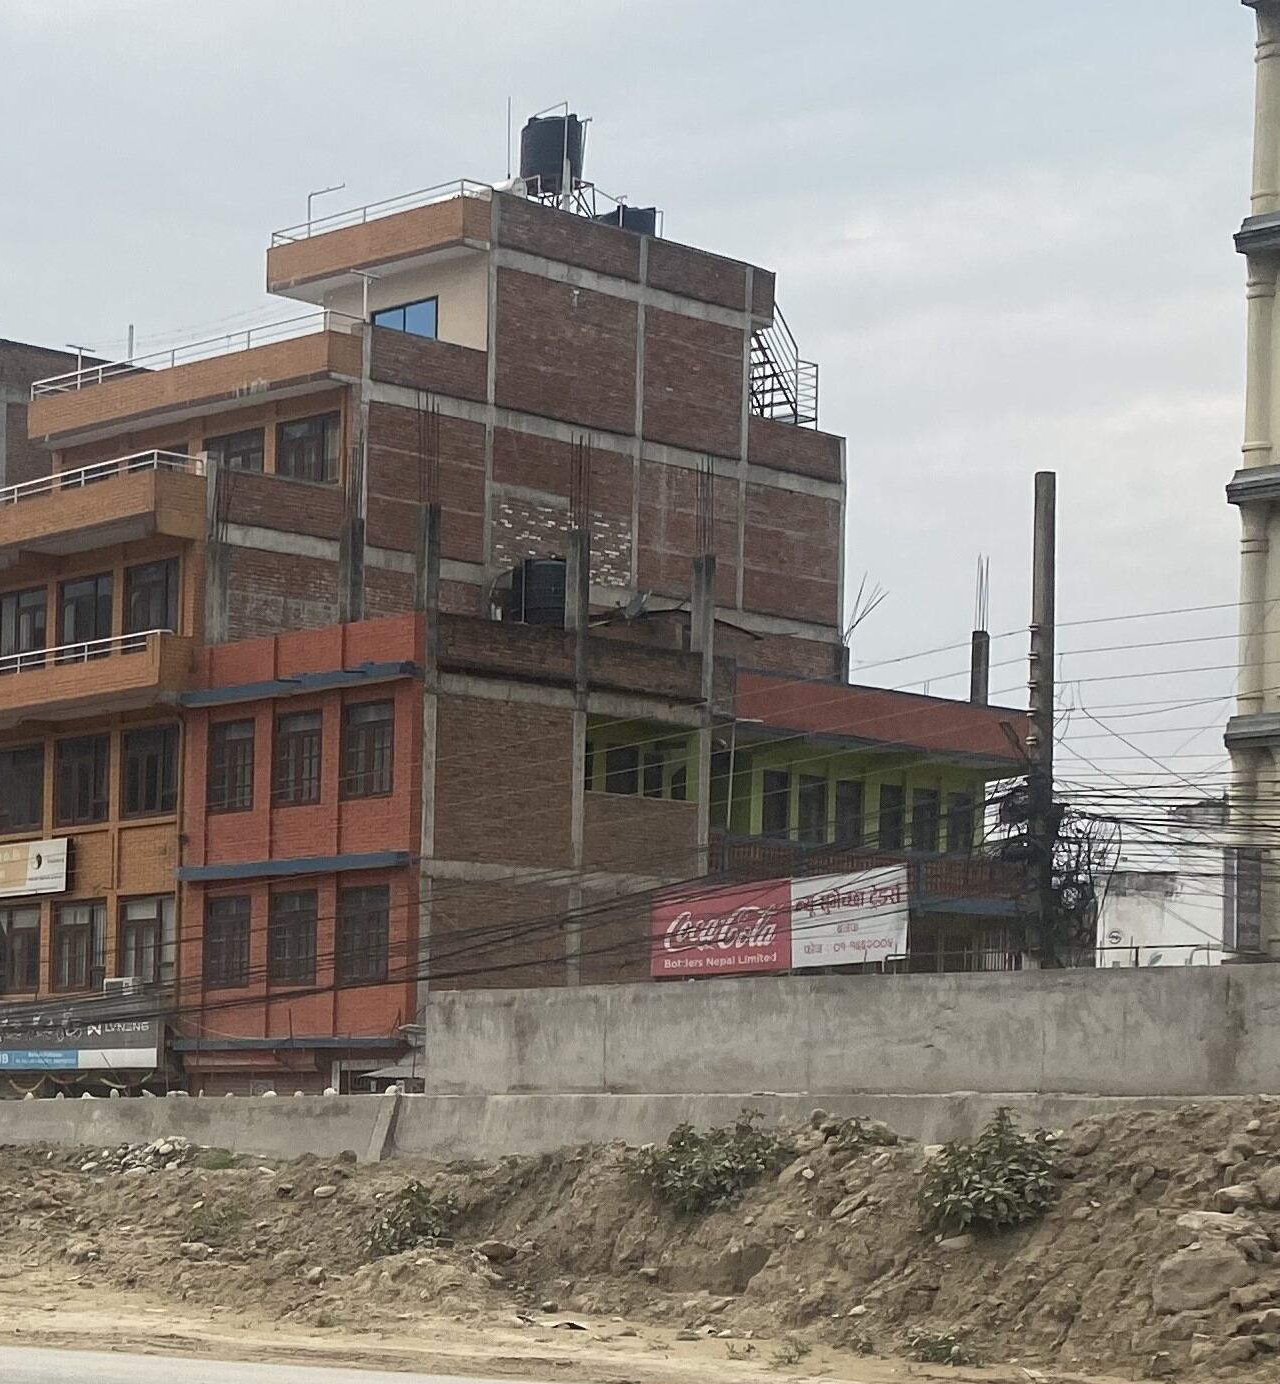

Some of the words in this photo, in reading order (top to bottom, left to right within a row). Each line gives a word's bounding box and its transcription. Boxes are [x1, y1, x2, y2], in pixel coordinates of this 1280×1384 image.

[663, 903, 783, 952] Coca-Cola
[706, 955, 736, 968] Nepal
[738, 953, 778, 965] Limited
